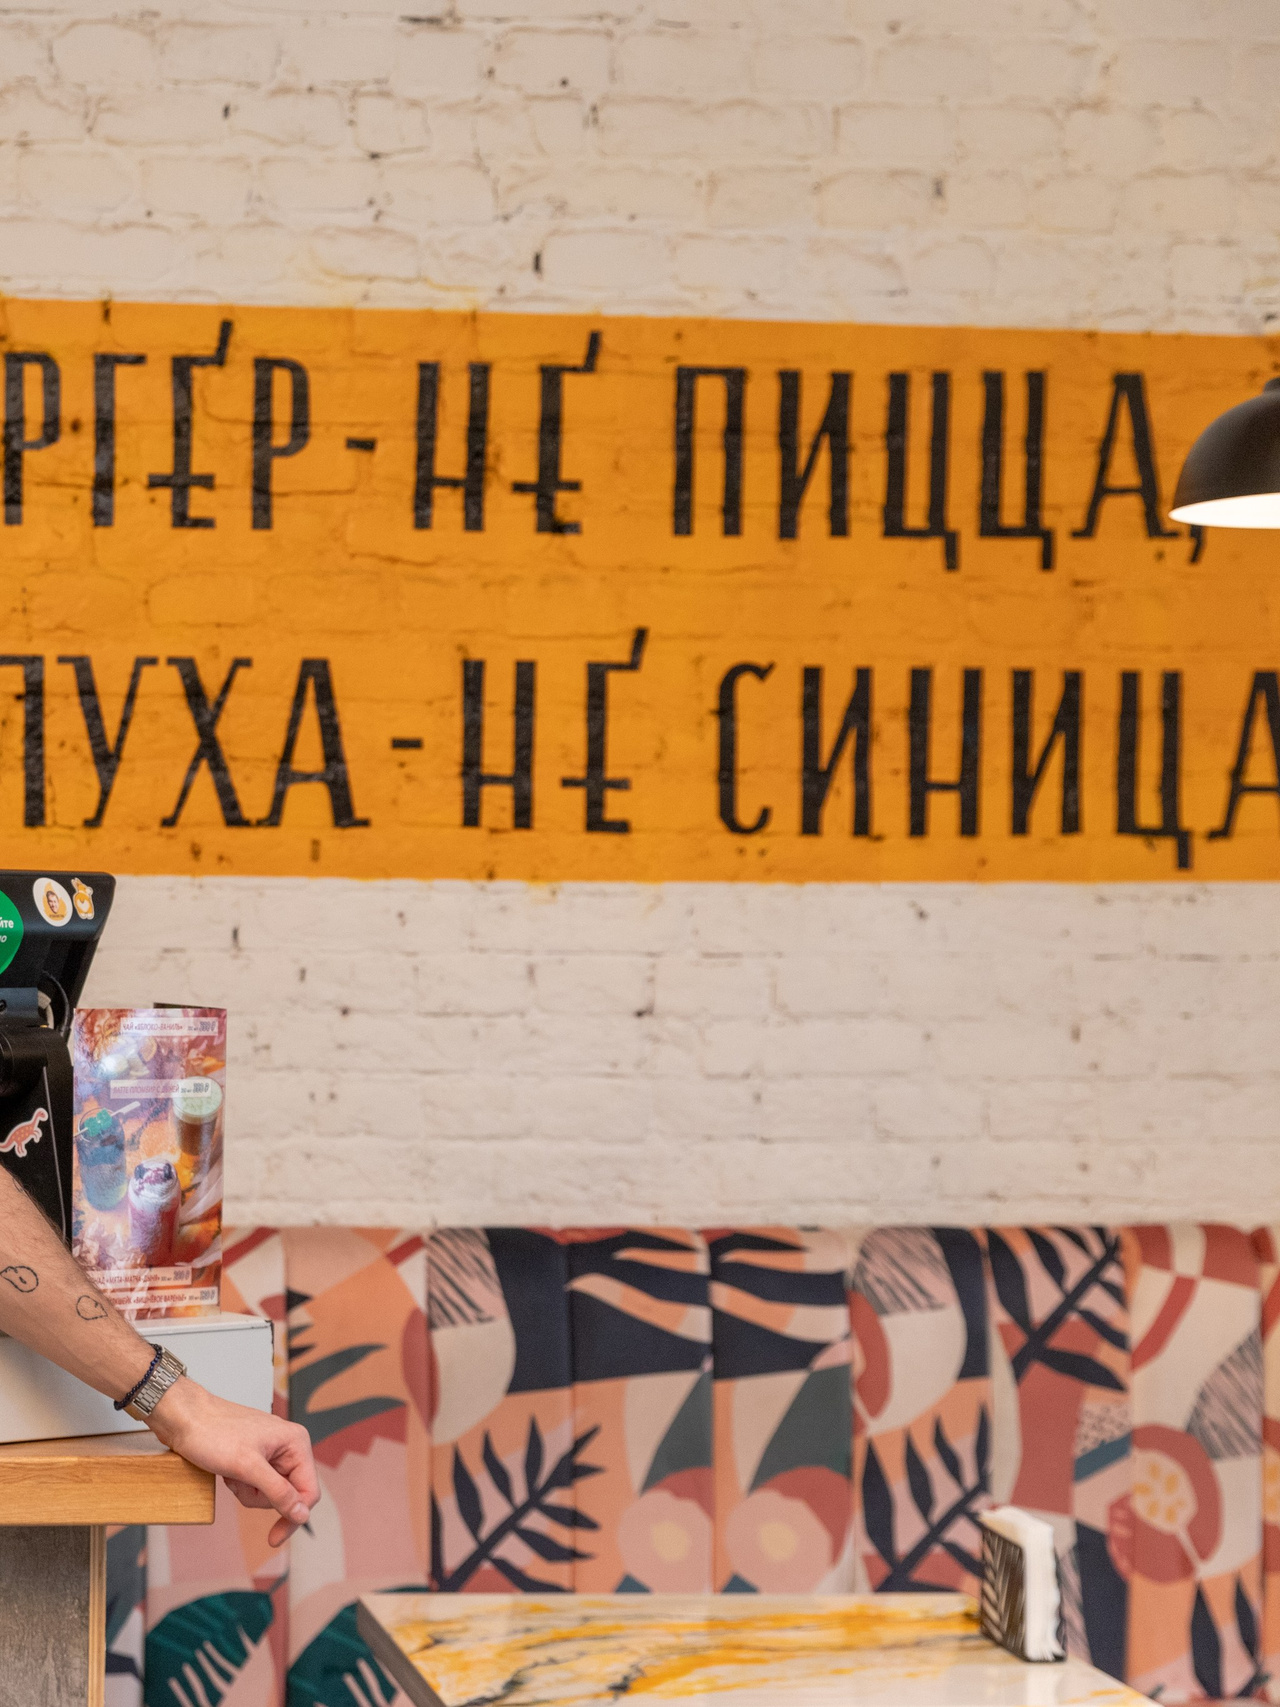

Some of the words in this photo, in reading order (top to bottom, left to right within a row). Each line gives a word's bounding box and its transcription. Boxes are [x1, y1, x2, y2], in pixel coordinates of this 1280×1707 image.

[413, 330, 602, 535] НЕ
[462, 627, 648, 834] НЕ
[716, 661, 1280, 870] СИНИЦА
